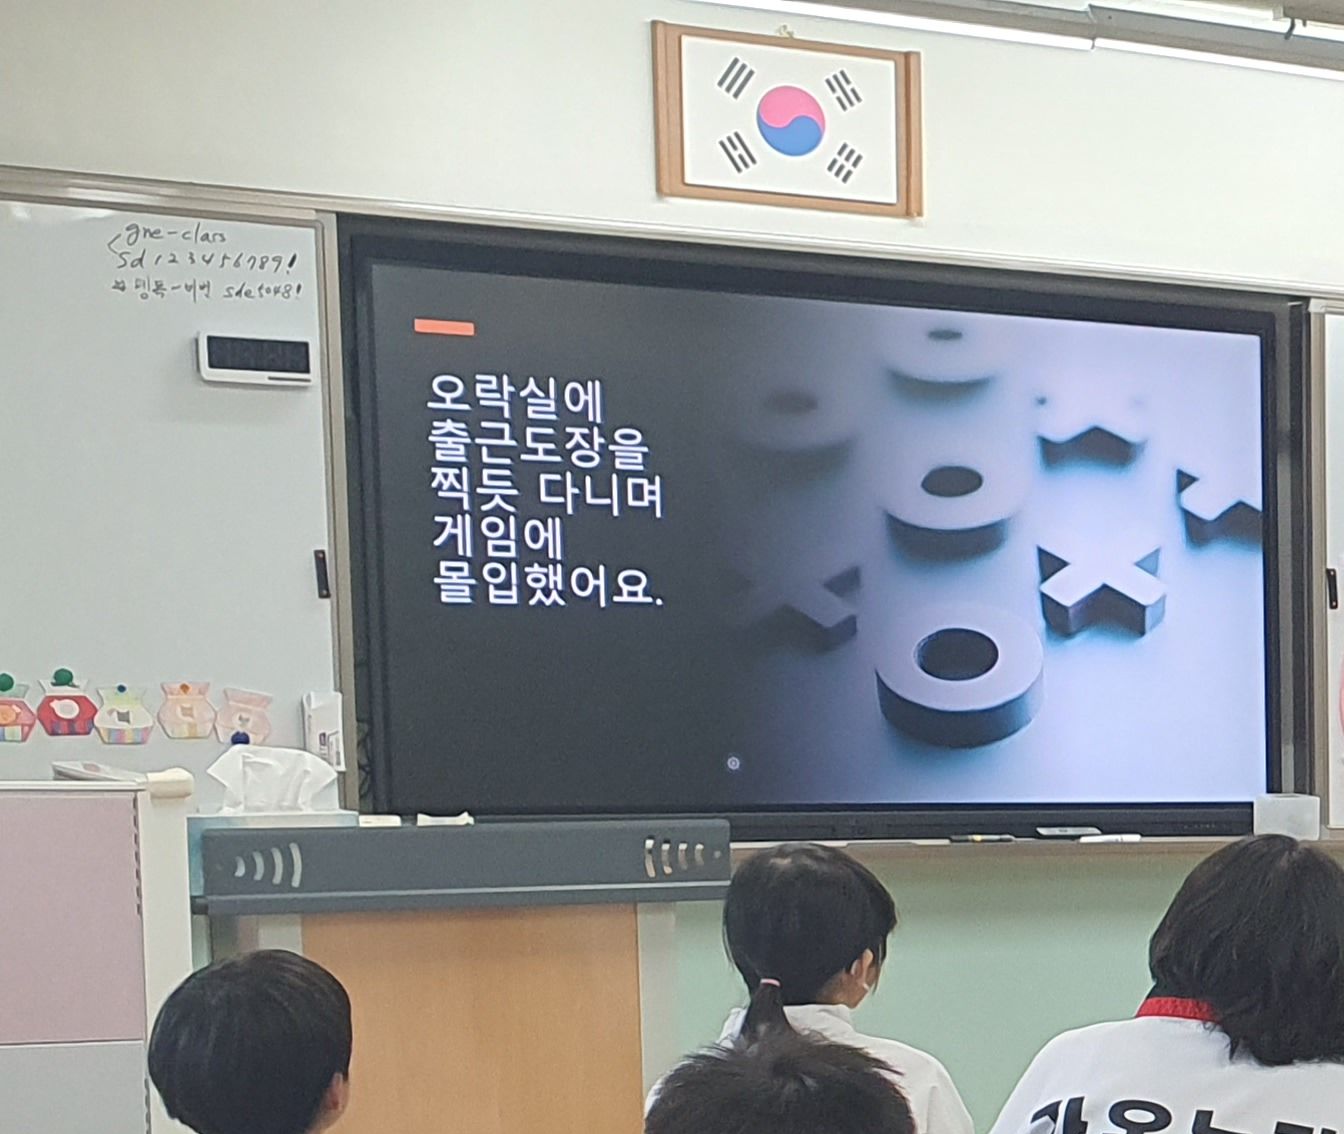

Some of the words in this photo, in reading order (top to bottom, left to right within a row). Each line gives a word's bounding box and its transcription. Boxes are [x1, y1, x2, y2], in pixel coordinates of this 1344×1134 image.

[426, 373, 603, 423] 오락실에
[427, 419, 649, 472] 출근도장을
[430, 466, 520, 513] 찍듯
[538, 471, 663, 519] 다니며
[432, 513, 564, 560] 게임에
[433, 560, 664, 608] 몰입했어요.
